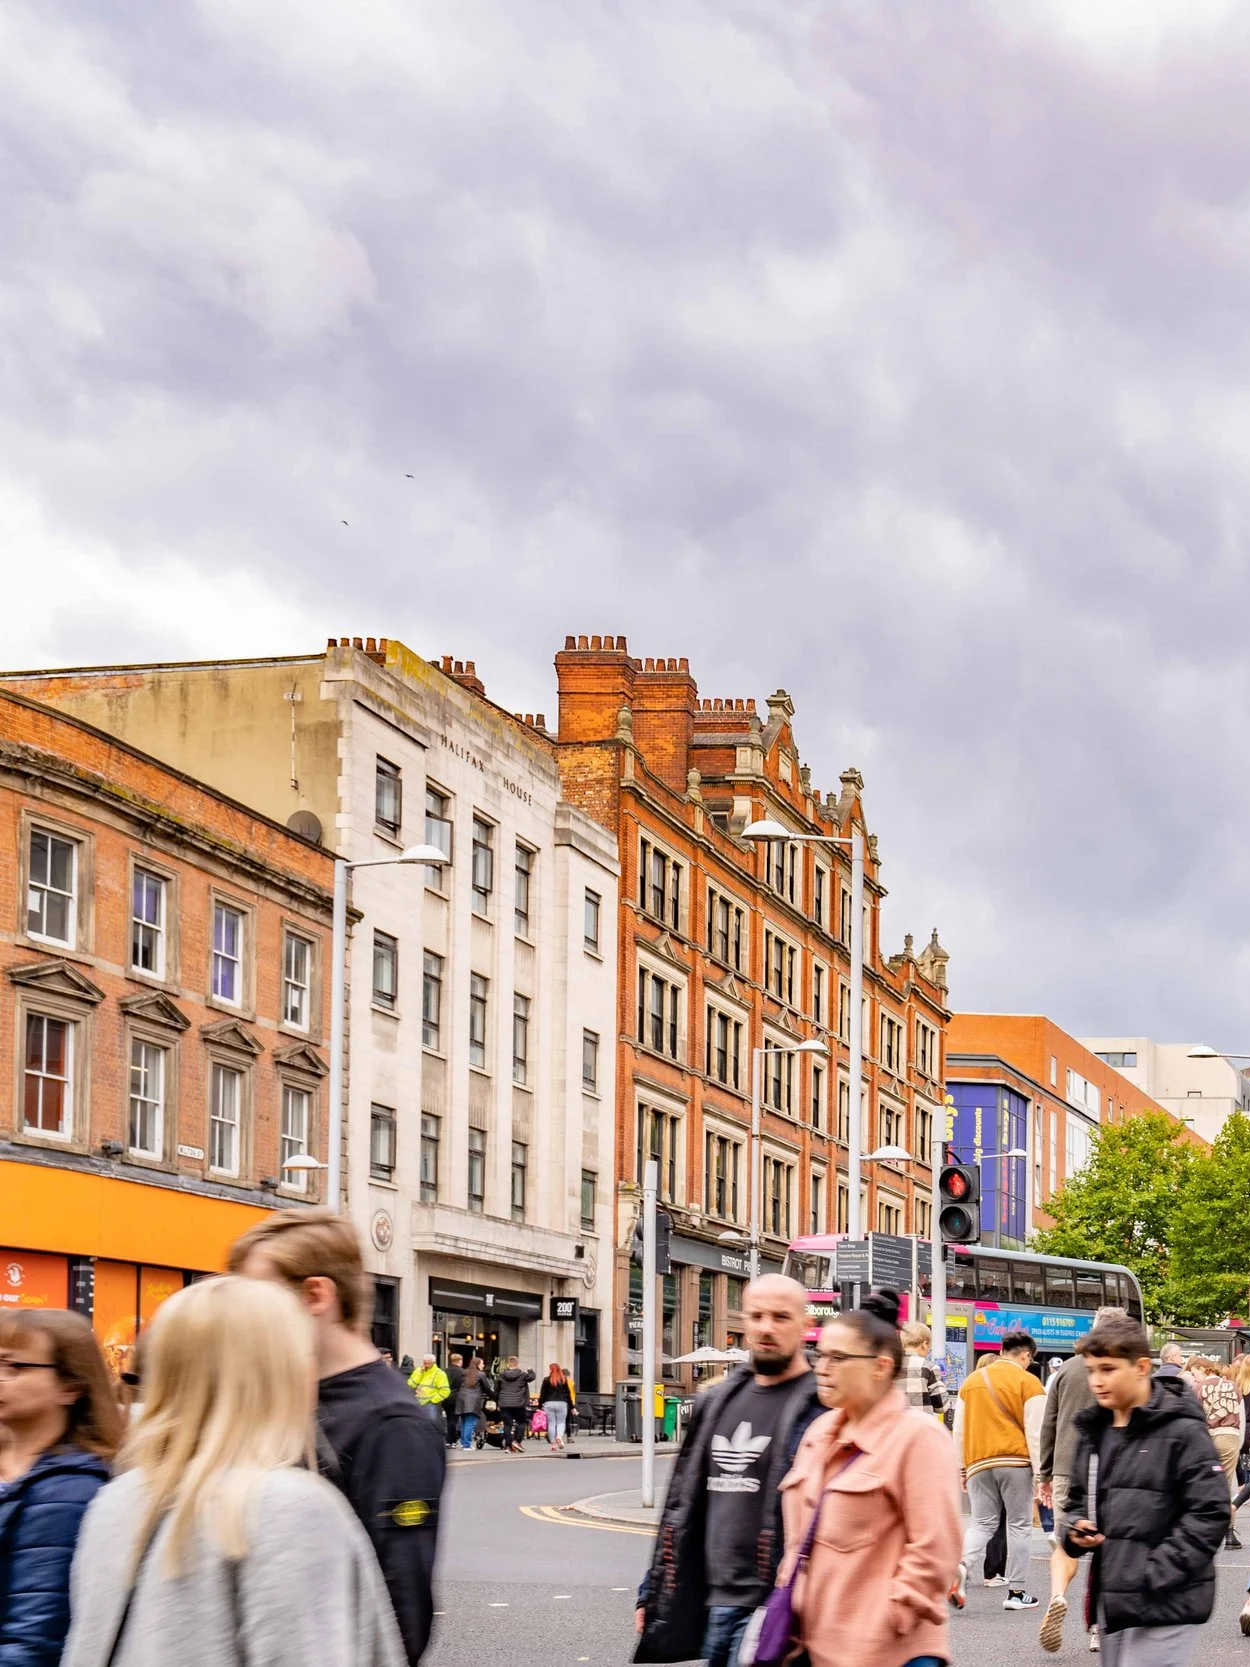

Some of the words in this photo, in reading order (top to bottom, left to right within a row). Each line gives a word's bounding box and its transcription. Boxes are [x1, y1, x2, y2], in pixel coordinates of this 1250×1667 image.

[441, 733, 484, 773] HALIFAX
[503, 776, 532, 807] HOUSE
[973, 1107, 983, 1147] discounts
[721, 1254, 743, 1271] BISTROT
